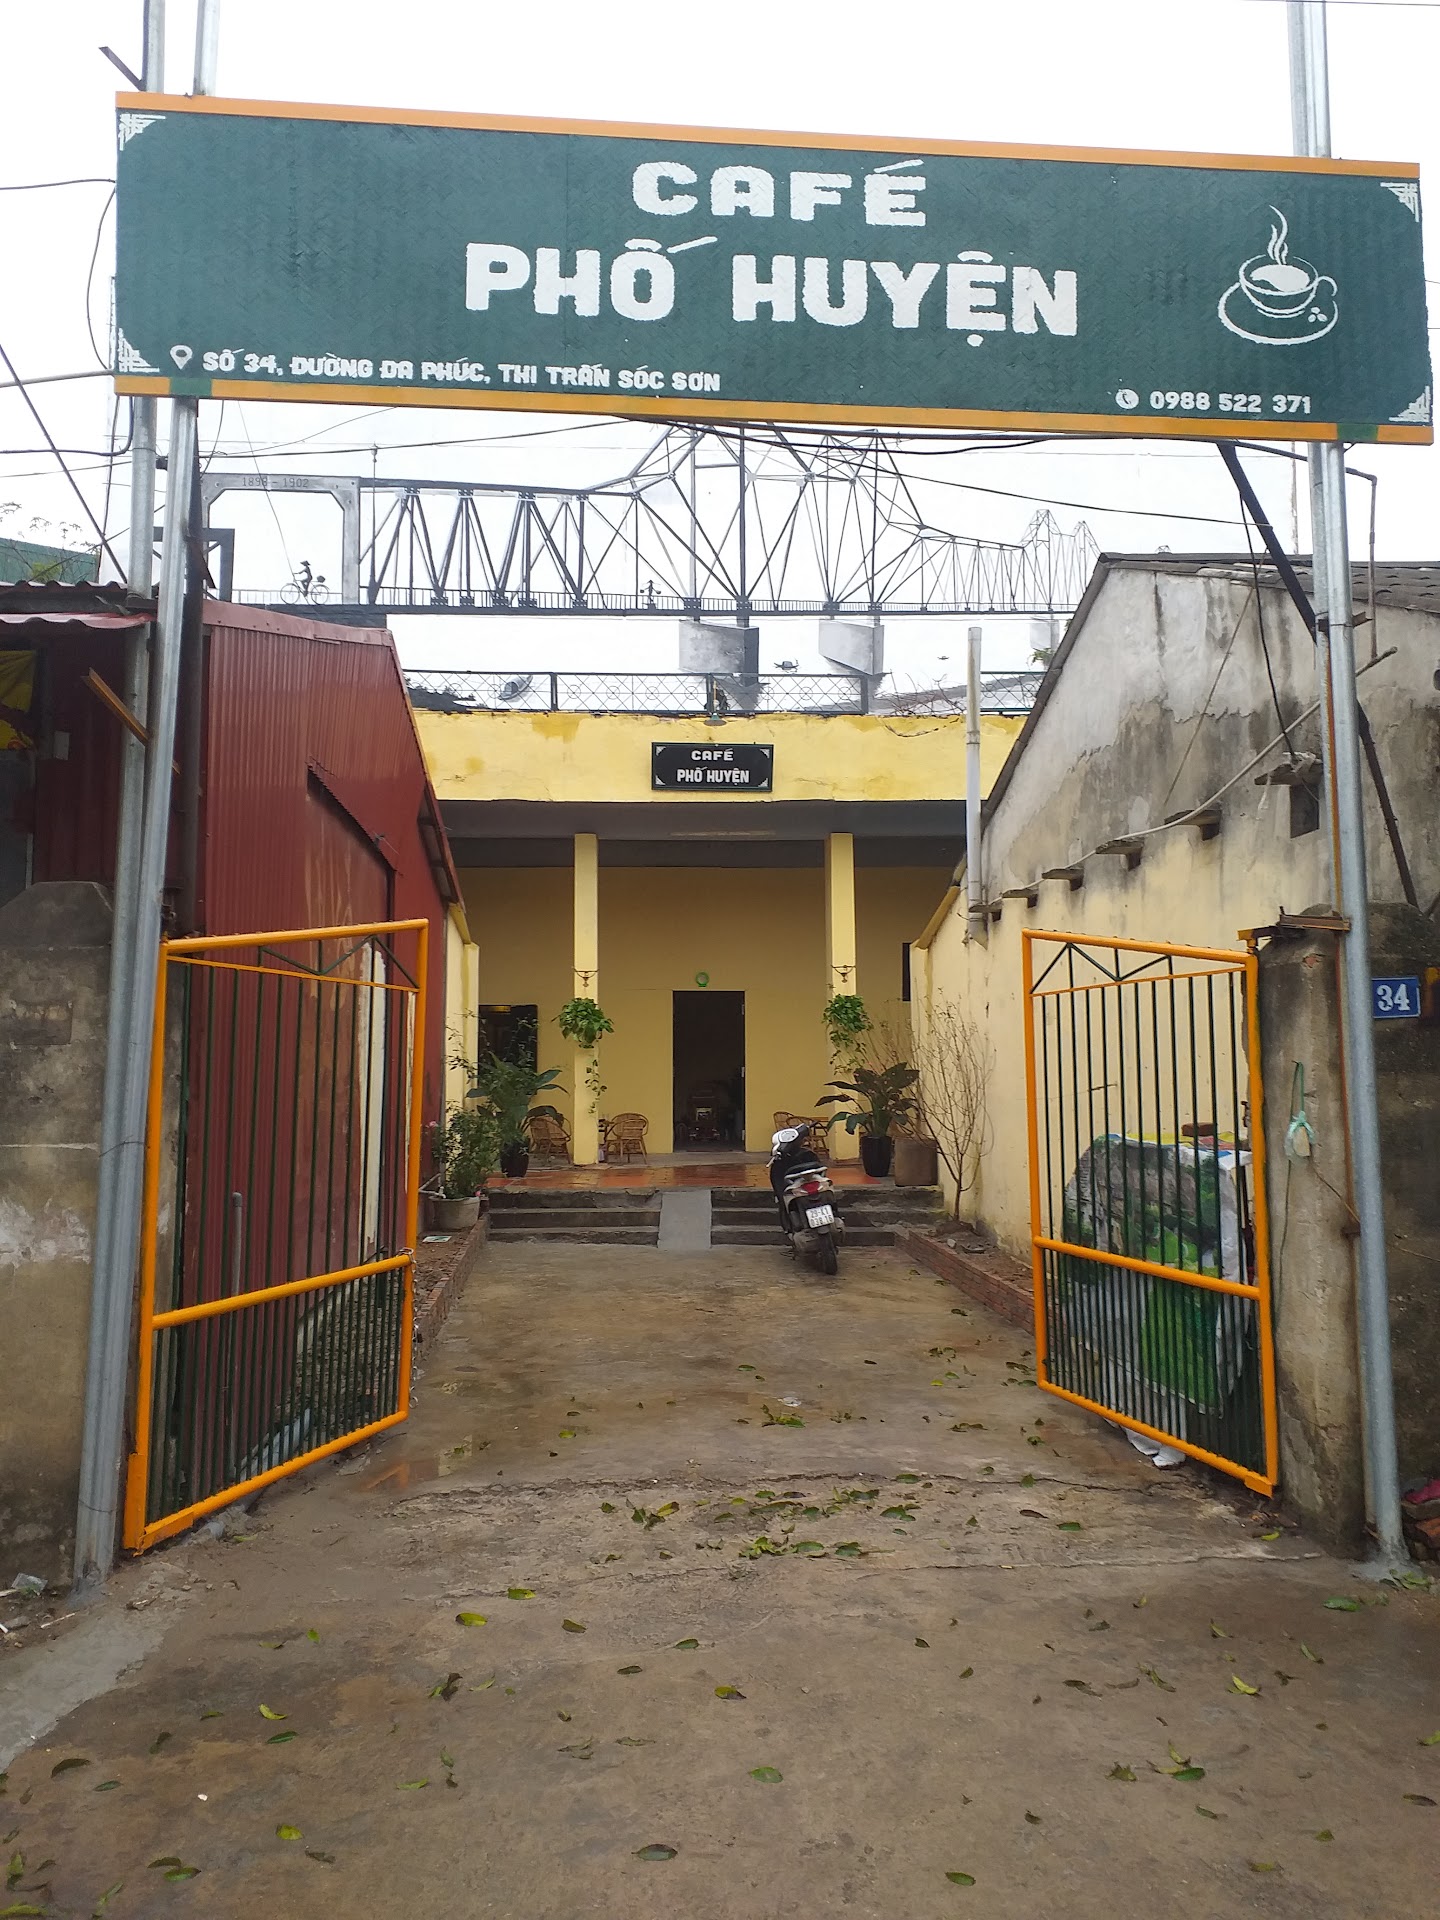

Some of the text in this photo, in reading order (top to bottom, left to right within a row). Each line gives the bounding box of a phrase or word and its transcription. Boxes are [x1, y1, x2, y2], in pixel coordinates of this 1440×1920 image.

[632, 159, 926, 226] CAFÉ
[466, 236, 1078, 347] PHỐ HUYỆN
[203, 348, 245, 372] SỐ
[244, 353, 283, 376] 34,
[289, 352, 373, 379] ĐƯỜNG
[378, 359, 414, 380] ĐA
[421, 357, 491, 385] PHÚC,
[545, 363, 610, 389] TRẤN
[617, 365, 665, 390] SÓC
[671, 371, 721, 392] SƠN
[1150, 390, 1311, 415] 0988 522 371
[283, 477, 309, 488] 1902
[691, 748, 734, 761] CAFÉ
[676, 766, 750, 786] PHỐ HUYỆN
[1376, 983, 1411, 1012] 34
